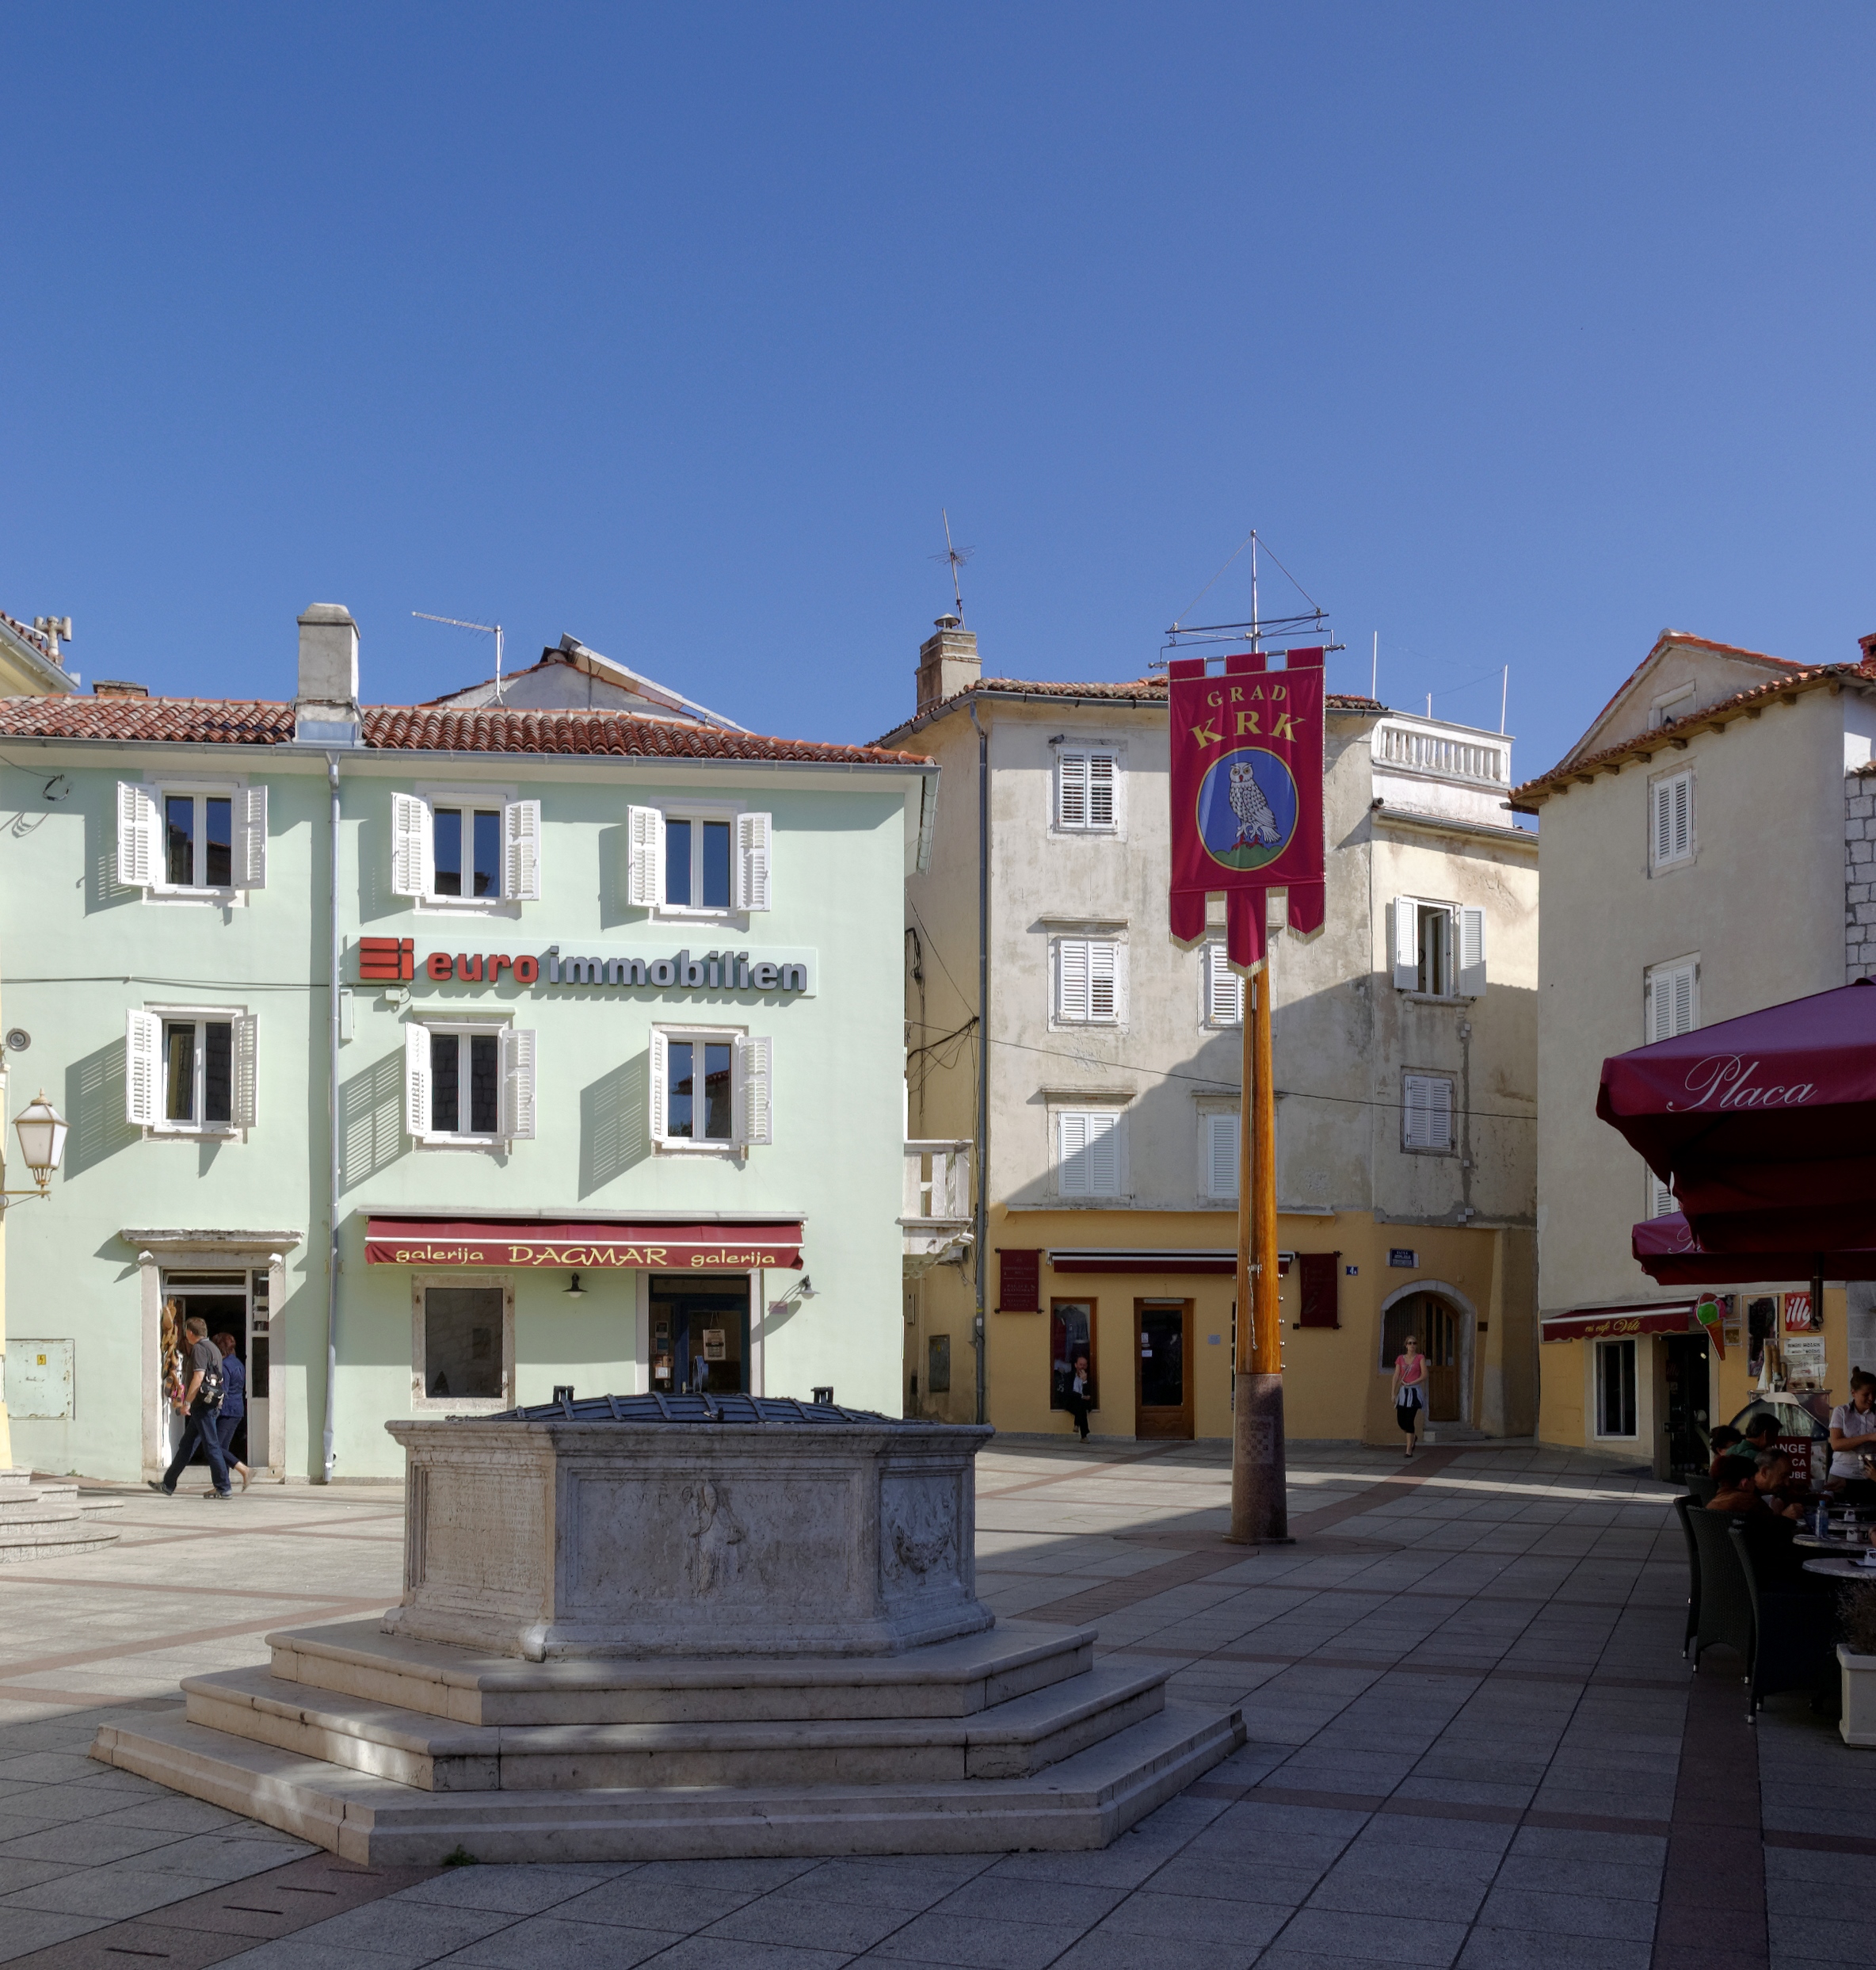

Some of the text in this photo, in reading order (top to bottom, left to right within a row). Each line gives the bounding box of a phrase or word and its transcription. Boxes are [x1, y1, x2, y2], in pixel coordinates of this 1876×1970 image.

[1207, 684, 1287, 708] GRAD
[1188, 711, 1306, 750] KRK
[426, 945, 808, 992] euro immobilien
[1666, 1053, 1818, 1113] Placa
[395, 1245, 776, 1269] galerija DAGMAR galerija
[1786, 1296, 1811, 1328] illy
